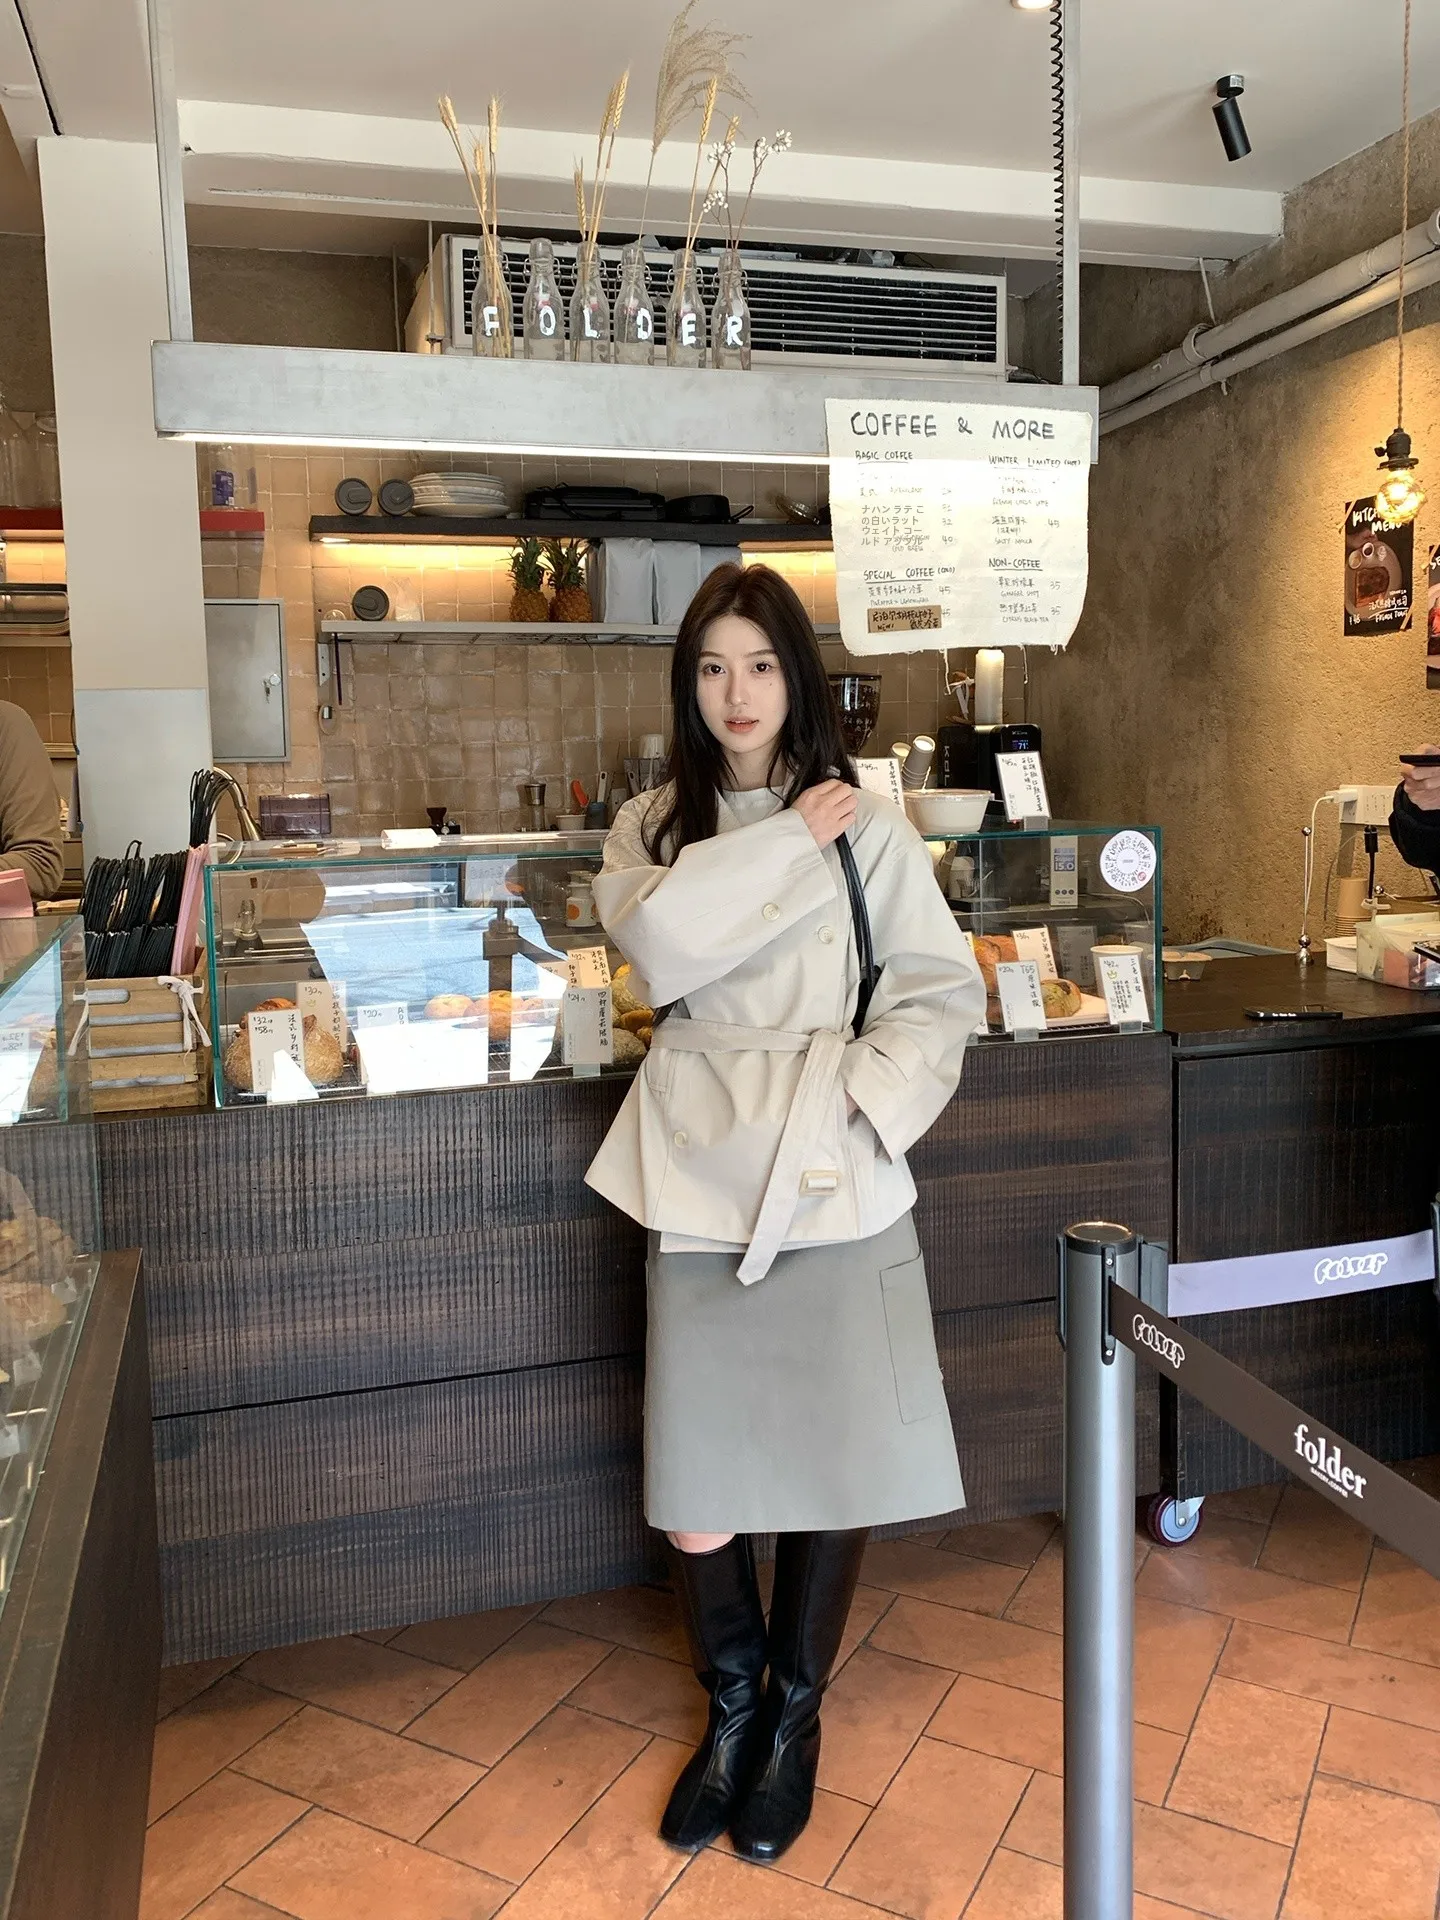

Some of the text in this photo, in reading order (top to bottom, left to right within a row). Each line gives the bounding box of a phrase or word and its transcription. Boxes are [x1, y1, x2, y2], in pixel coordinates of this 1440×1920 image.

[851, 411, 1055, 440] COFFEE & MORE
[855, 450, 913, 460] BASIC COFFEE
[989, 455, 1019, 465] WINTER
[1028, 457, 1061, 468] LIMITED
[1047, 518, 1060, 528] 45
[988, 558, 1041, 568] NON-COFFEE
[863, 569, 896, 581] SPECIAL
[905, 568, 934, 578] COFFEE
[938, 586, 951, 595] 45
[1050, 581, 1061, 590] 35
[1050, 606, 1061, 616] 35
[1055, 862, 1075, 871] 15.0
[1294, 1424, 1367, 1499] folder
